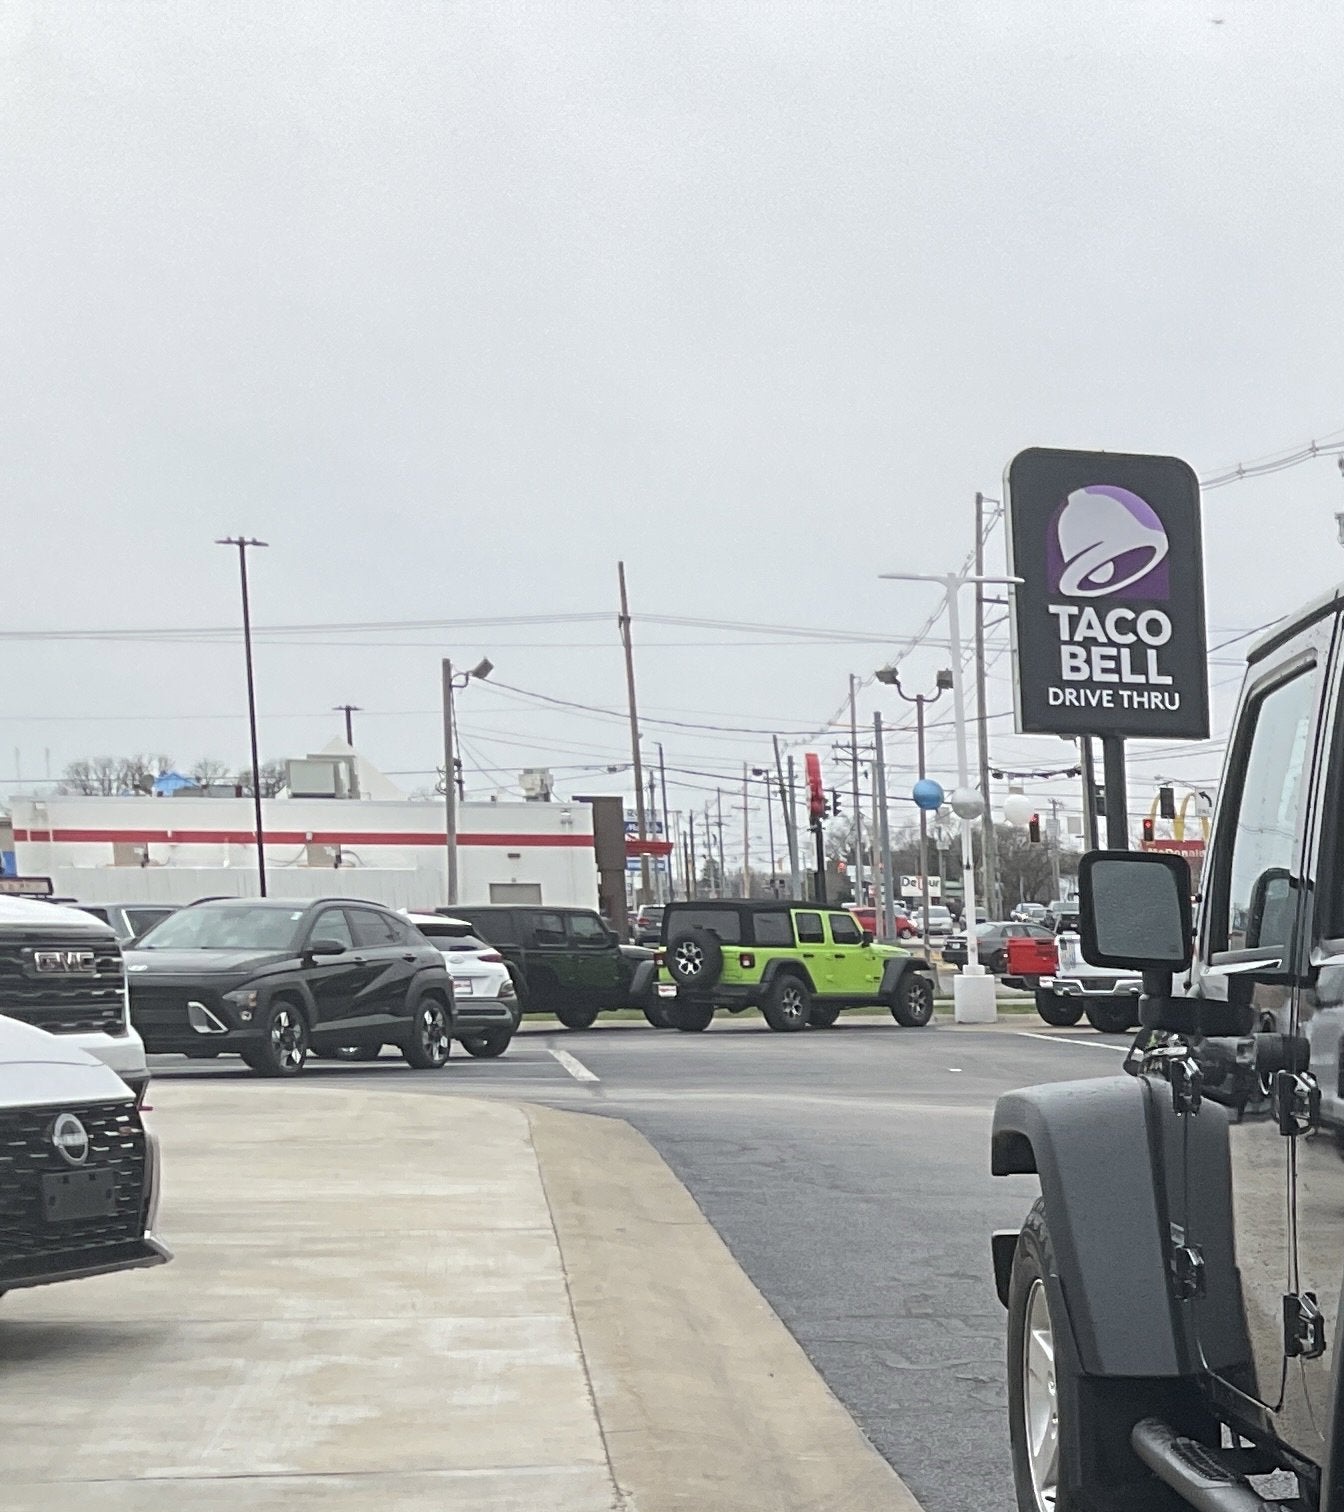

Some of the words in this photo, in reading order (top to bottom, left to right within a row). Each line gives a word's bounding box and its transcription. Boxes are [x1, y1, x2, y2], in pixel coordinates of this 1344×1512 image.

[1048, 604, 1173, 647] TACO
[1060, 644, 1173, 686] BELL
[1047, 687, 1113, 708] DRIVE
[1118, 690, 1181, 711] THRU
[34, 951, 97, 973] GMC
